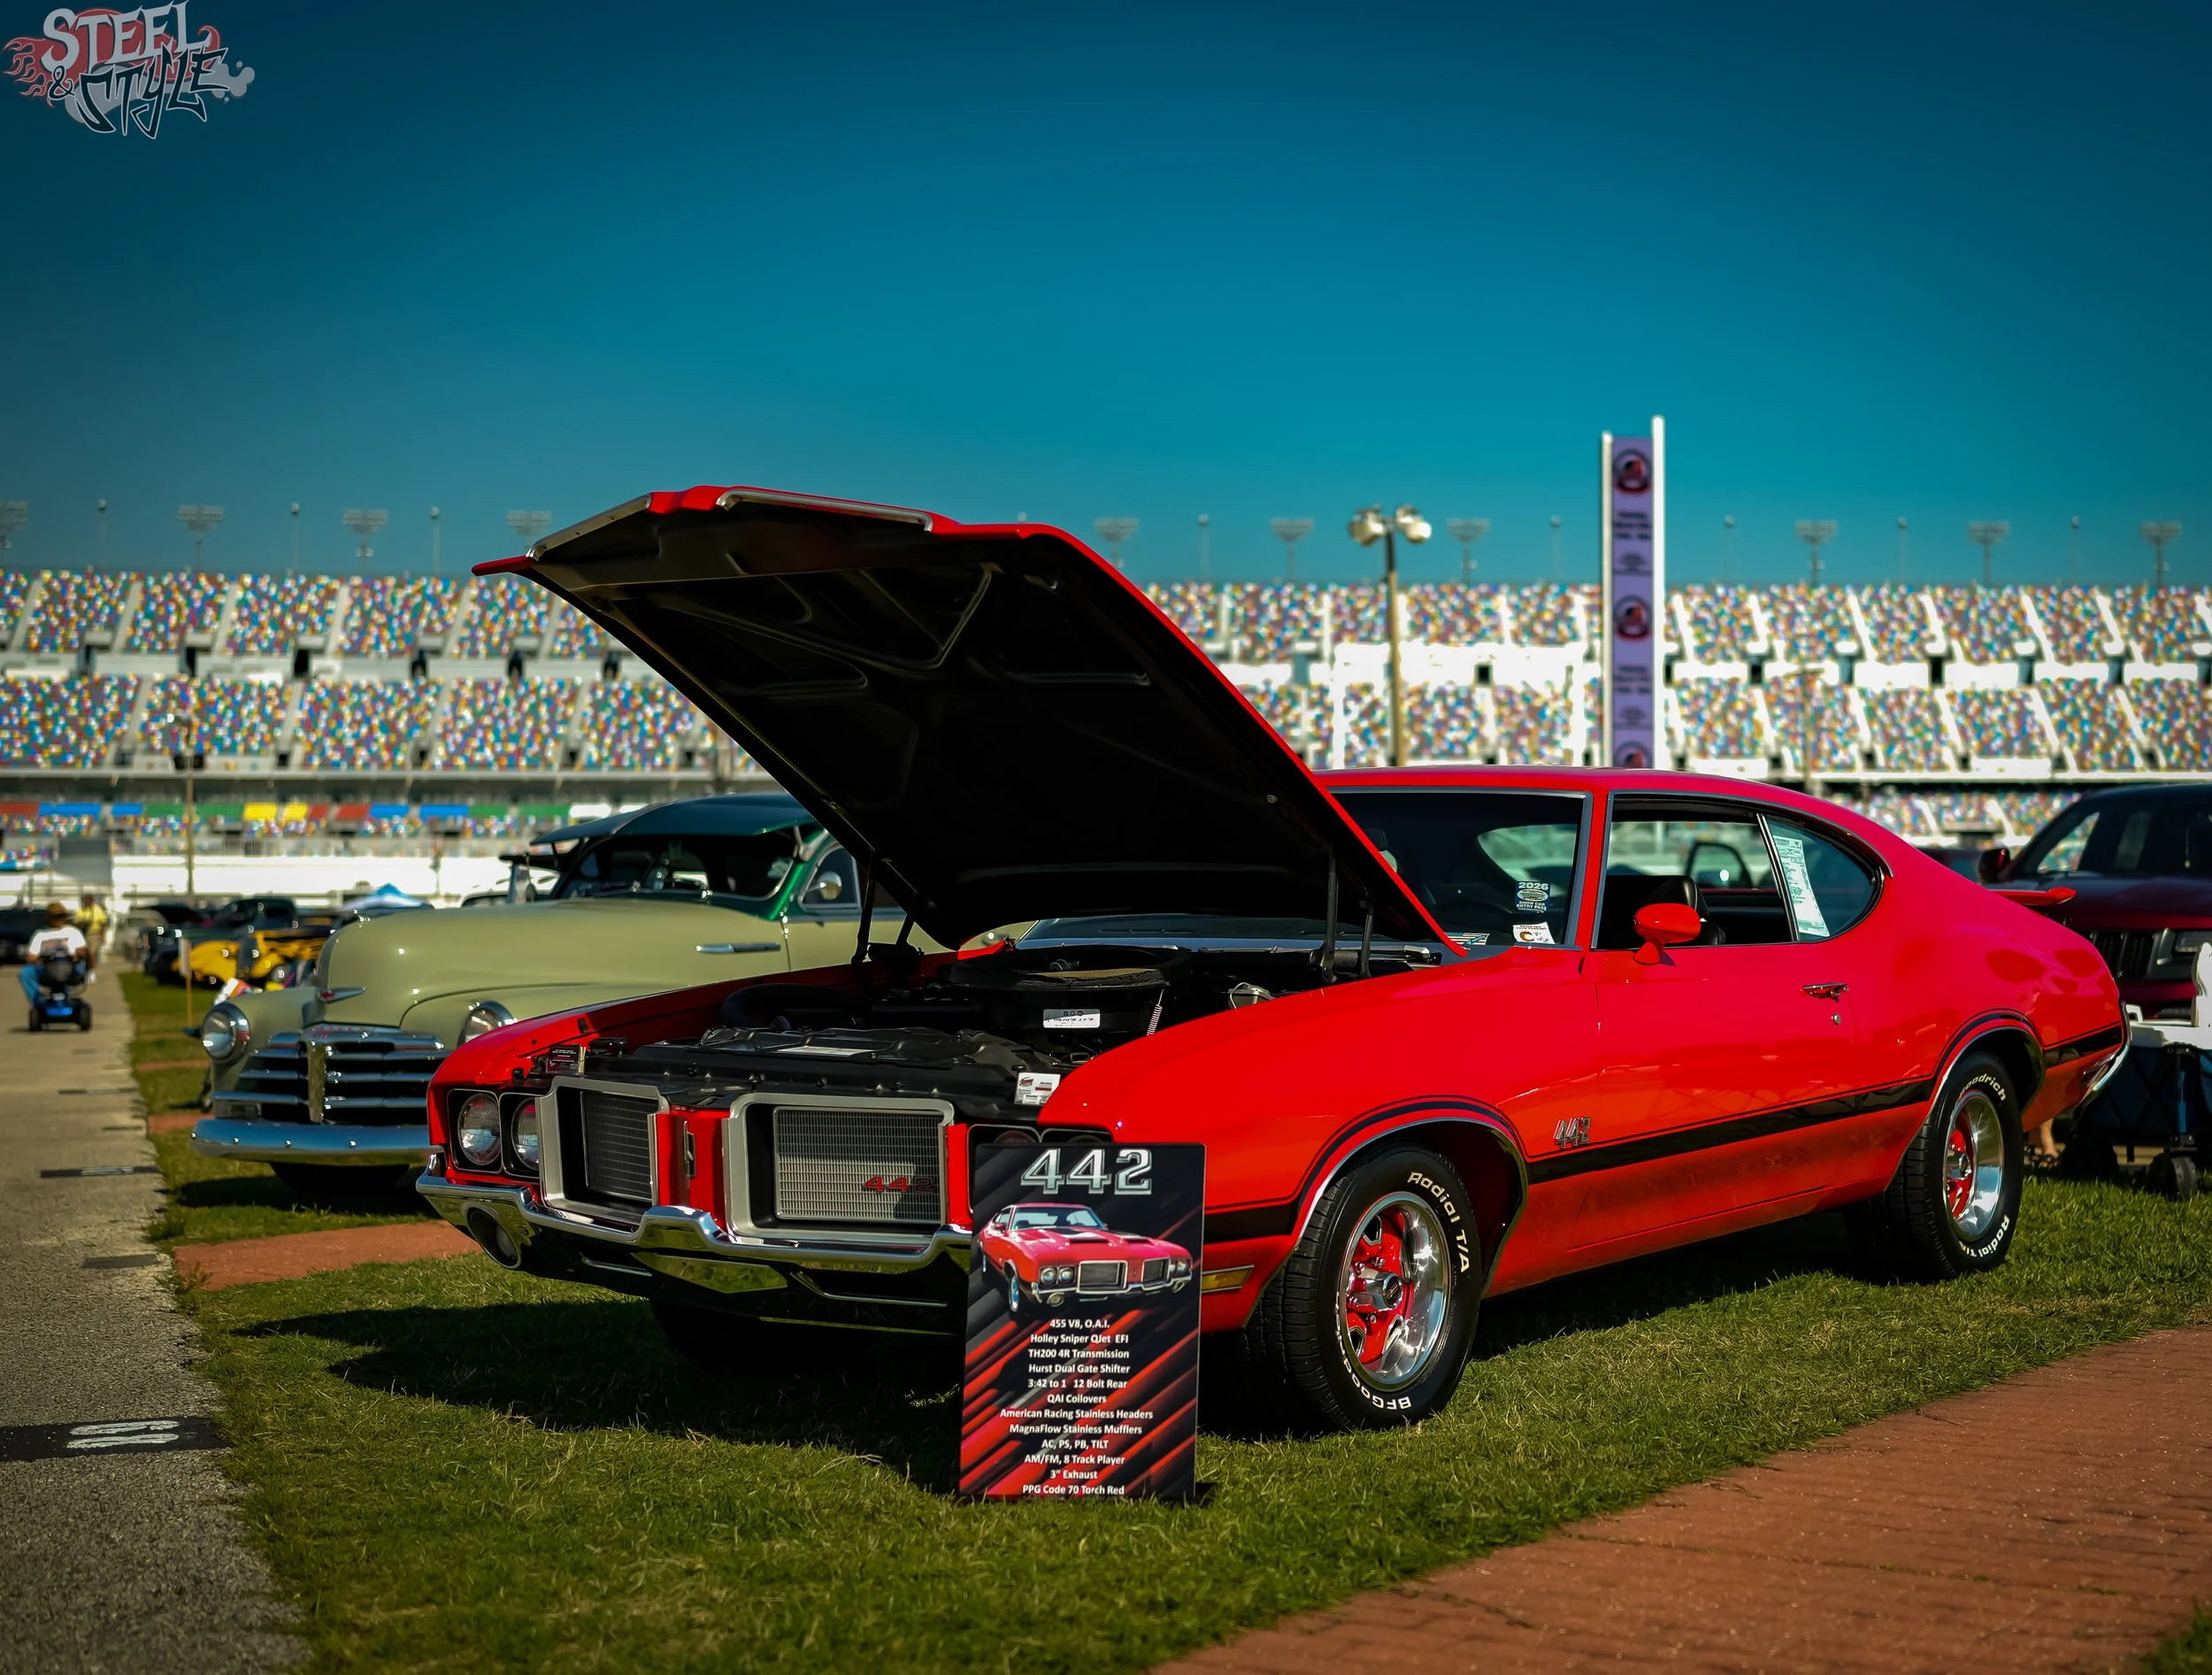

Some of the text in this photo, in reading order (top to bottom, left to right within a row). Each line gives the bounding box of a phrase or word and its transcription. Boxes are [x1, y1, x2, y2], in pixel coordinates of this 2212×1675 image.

[1518, 881, 1549, 891] 2026
[1553, 1116, 1591, 1149] 442
[1020, 1147, 1153, 1195] 442
[864, 1175, 935, 1195] 442
[1408, 1172, 1470, 1273] Radial T/A
[1978, 1215, 2010, 1257] Radial
[1049, 1318, 1110, 1330] 455 V8, O.A.I.
[1030, 1333, 1129, 1345] Holley Sniper QJet EFI
[1028, 1348, 1130, 1359] TH200 4R Transmission
[1028, 1364, 1131, 1374] Hurst Dual Gate Shifter
[1027, 1379, 1128, 1389] 3:42 to 1 12 Bolt Rear
[1065, 1394, 1107, 1403] Coilovers
[999, 1409, 1154, 1421] American Racing Stainless Headers
[1010, 1424, 1143, 1435] MagnaFlow Stainless Mufflers
[1041, 1440, 1110, 1450] AC, PS, PB, TILT
[1024, 1454, 1125, 1466] AM/FM, 8 Track Player
[1063, 1469, 1098, 1479] Exhaust
[1022, 1484, 1125, 1495] PPG Code 70 Torch Red
